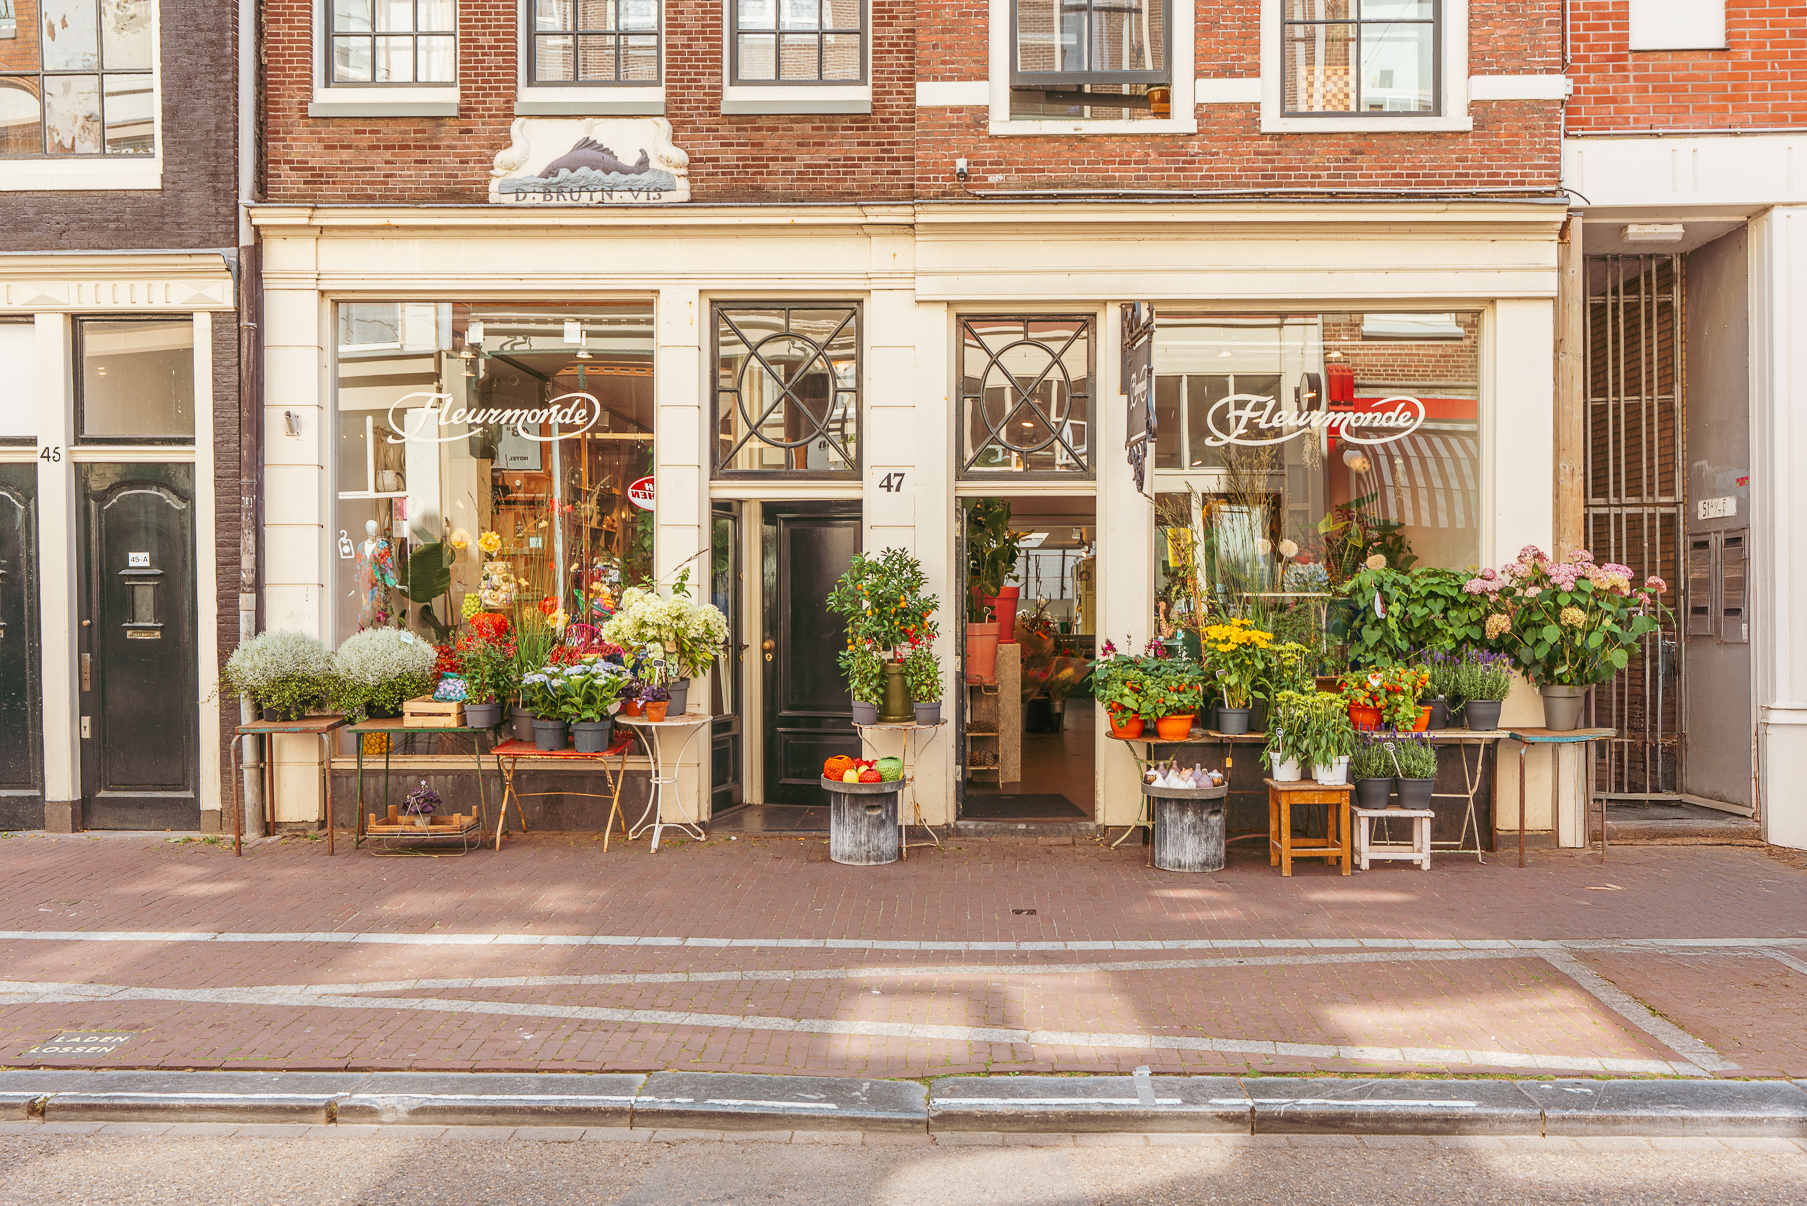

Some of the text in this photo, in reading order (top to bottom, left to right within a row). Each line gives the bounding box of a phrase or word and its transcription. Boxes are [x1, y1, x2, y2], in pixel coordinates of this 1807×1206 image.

[387, 392, 601, 444] Fleurmonde
[1204, 393, 1426, 447] Fleurmonde
[40, 446, 61, 463] 45
[879, 472, 906, 492] 47
[29, 1046, 116, 1054] LOSSEN
